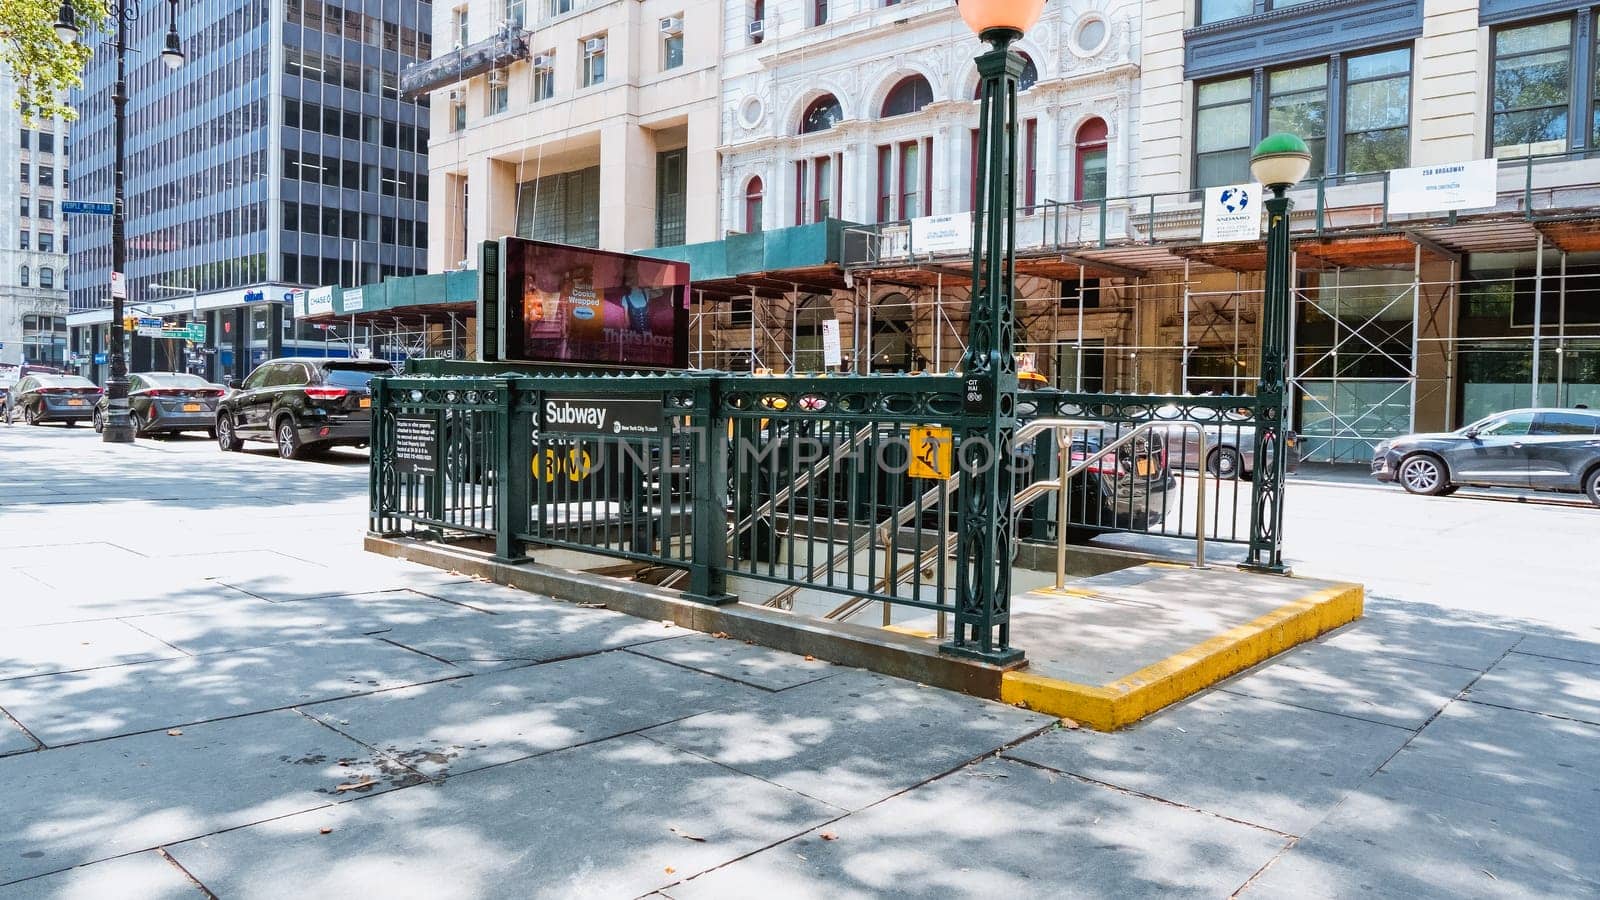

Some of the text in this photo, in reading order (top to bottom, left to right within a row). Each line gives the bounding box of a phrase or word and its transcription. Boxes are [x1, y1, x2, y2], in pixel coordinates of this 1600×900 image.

[1435, 166, 1465, 175] BROADWAY
[311, 296, 327, 305] CHASE
[568, 296, 600, 306] Wrapped
[434, 349, 453, 359] CHAS
[545, 401, 607, 429] Subway
